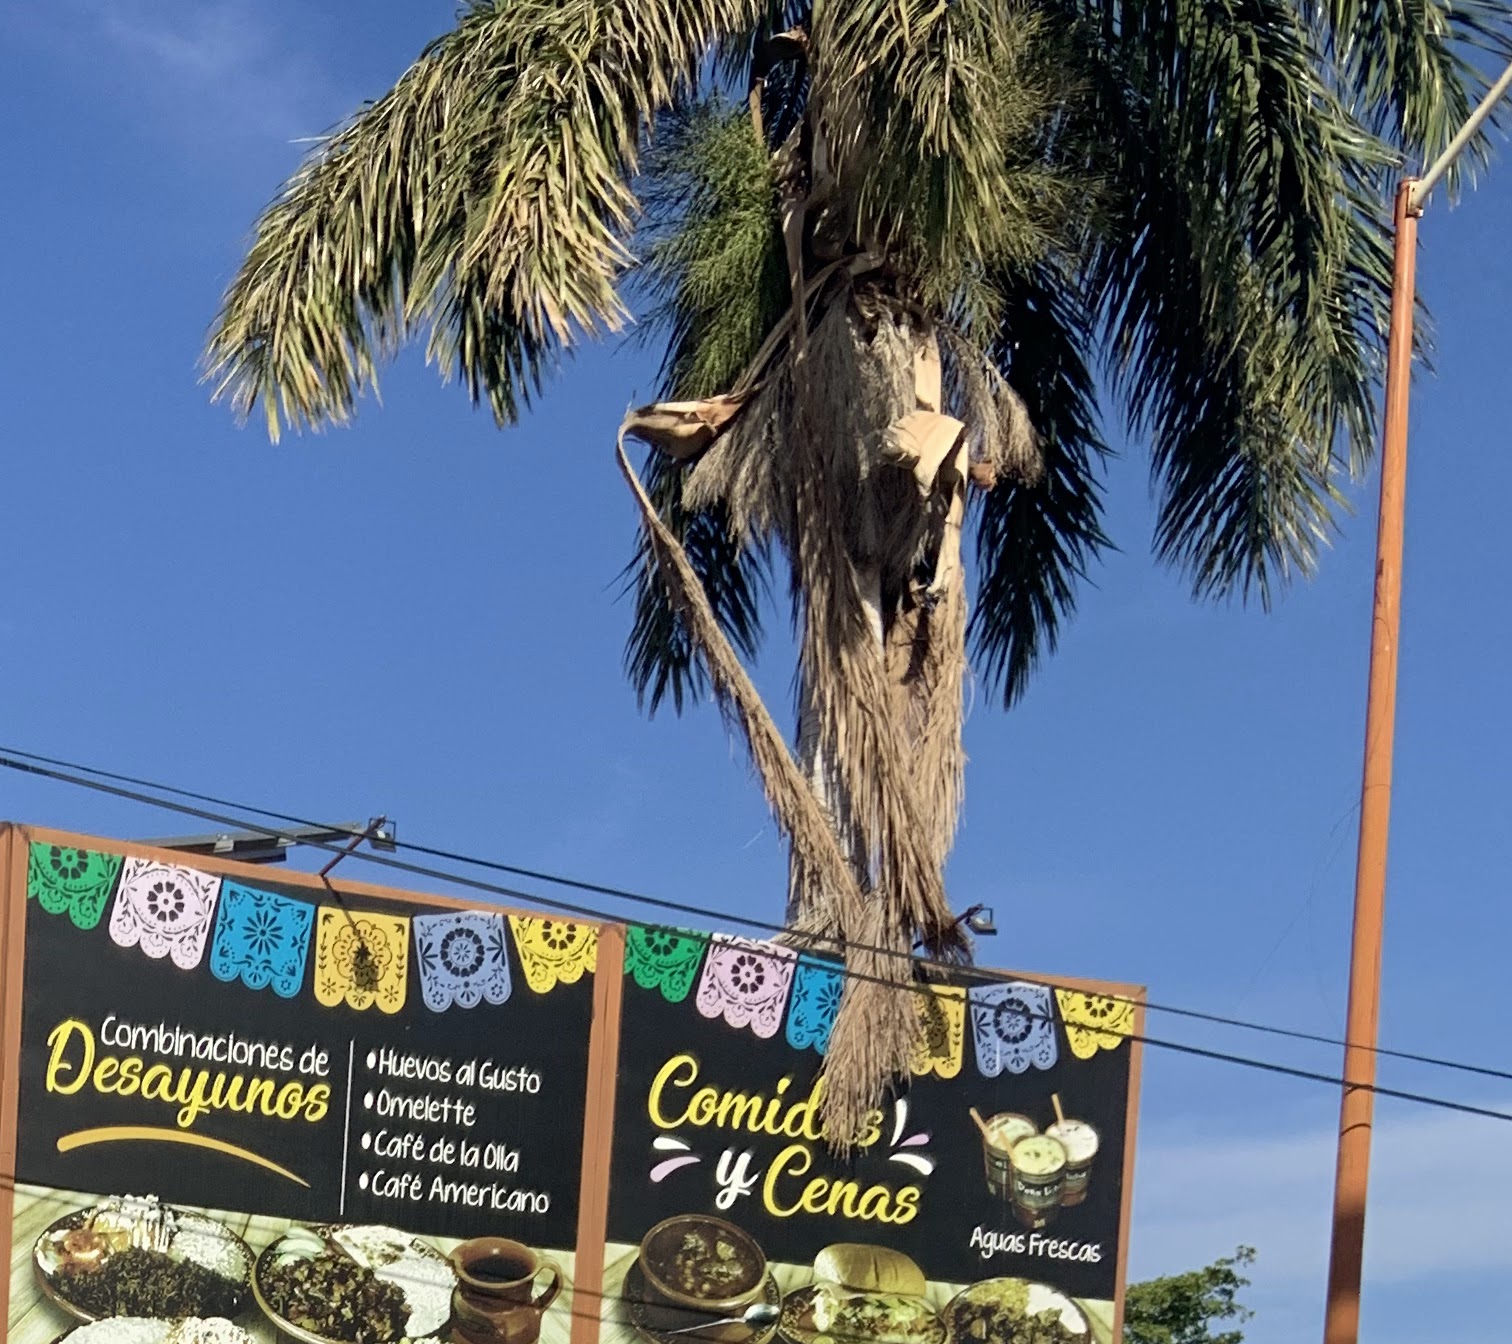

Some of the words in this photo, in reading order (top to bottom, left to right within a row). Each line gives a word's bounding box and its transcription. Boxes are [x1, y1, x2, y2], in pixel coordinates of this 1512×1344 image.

[100, 1016, 294, 1071] Combinaciones
[299, 1046, 330, 1076] de
[46, 1020, 332, 1128] Desayunos
[379, 1047, 452, 1083] Huevos
[456, 1060, 476, 1086] al
[479, 1061, 541, 1093] Gusto
[377, 1090, 477, 1126] Omelette
[648, 1054, 884, 1148] Comids
[374, 1130, 424, 1161] Café
[429, 1138, 455, 1164] de
[460, 1140, 480, 1168] la
[484, 1143, 519, 1172] Olla
[371, 1170, 423, 1200] Café
[428, 1176, 550, 1213] Americano
[715, 1149, 759, 1210] y
[763, 1145, 920, 1225] Cenas
[970, 1227, 1026, 1259] Aguas
[1028, 1234, 1102, 1263] Frescas
